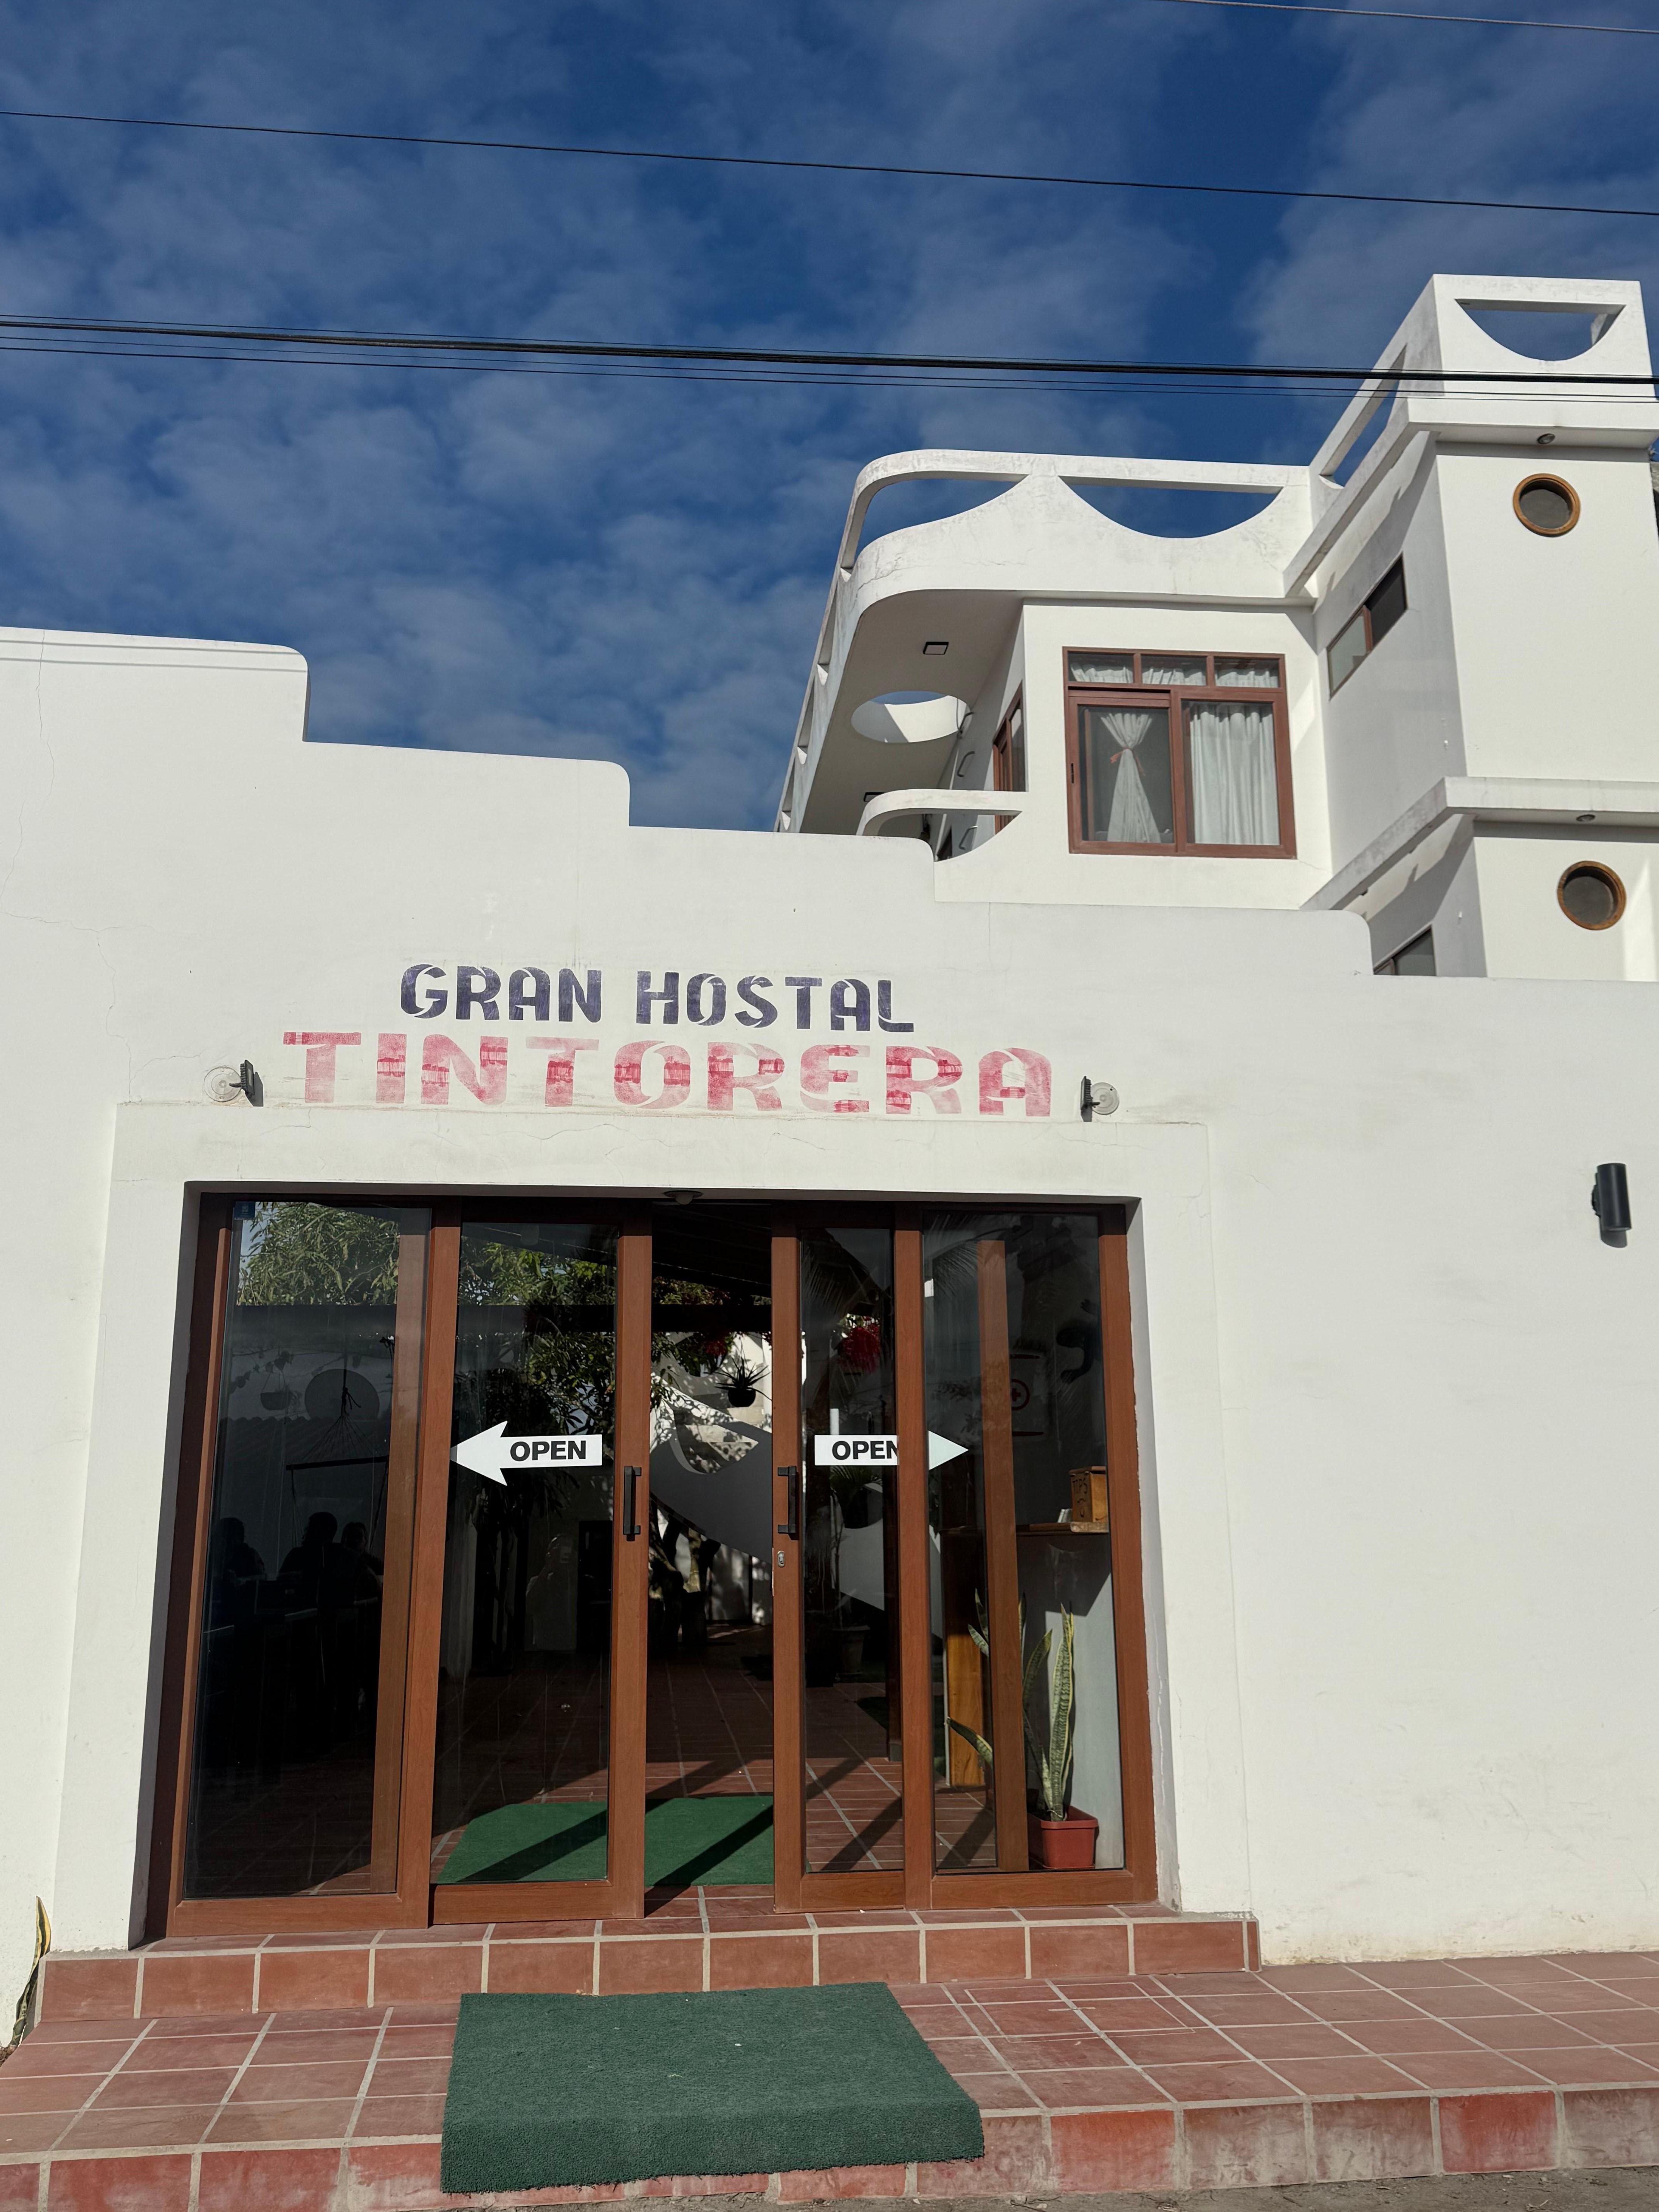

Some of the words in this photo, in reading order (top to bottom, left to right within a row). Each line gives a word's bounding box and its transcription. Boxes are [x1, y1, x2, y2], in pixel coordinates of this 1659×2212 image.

[400, 964, 601, 1023] GRAN
[636, 971, 914, 1033] HOSTAL
[283, 1031, 1051, 1117] TINTORERA
[510, 1440, 586, 1462] OPEN
[1072, 1477, 1088, 1494] TIPS
